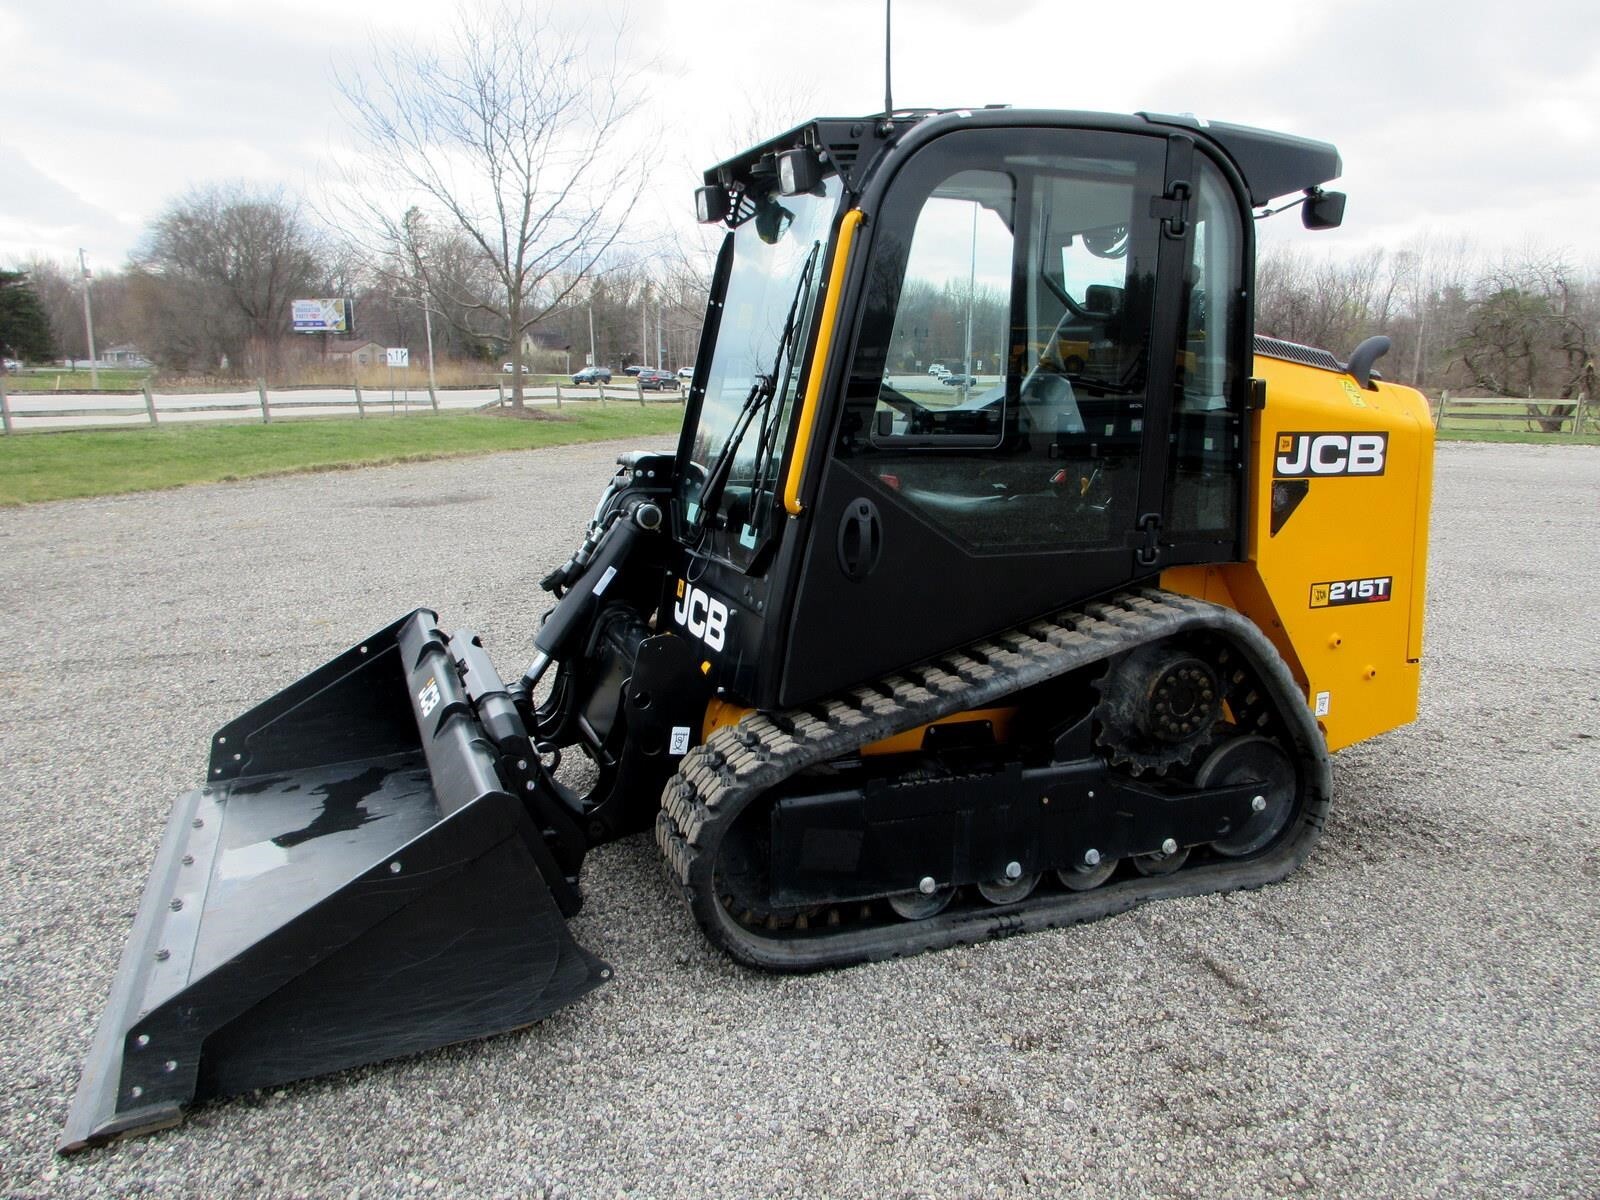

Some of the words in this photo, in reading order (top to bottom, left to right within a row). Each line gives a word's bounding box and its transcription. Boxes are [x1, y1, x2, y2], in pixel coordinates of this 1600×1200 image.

[1276, 435, 1385, 474] JCB
[1329, 578, 1389, 600] 215T
[674, 583, 728, 652] JCB
[418, 681, 441, 718] JCB
